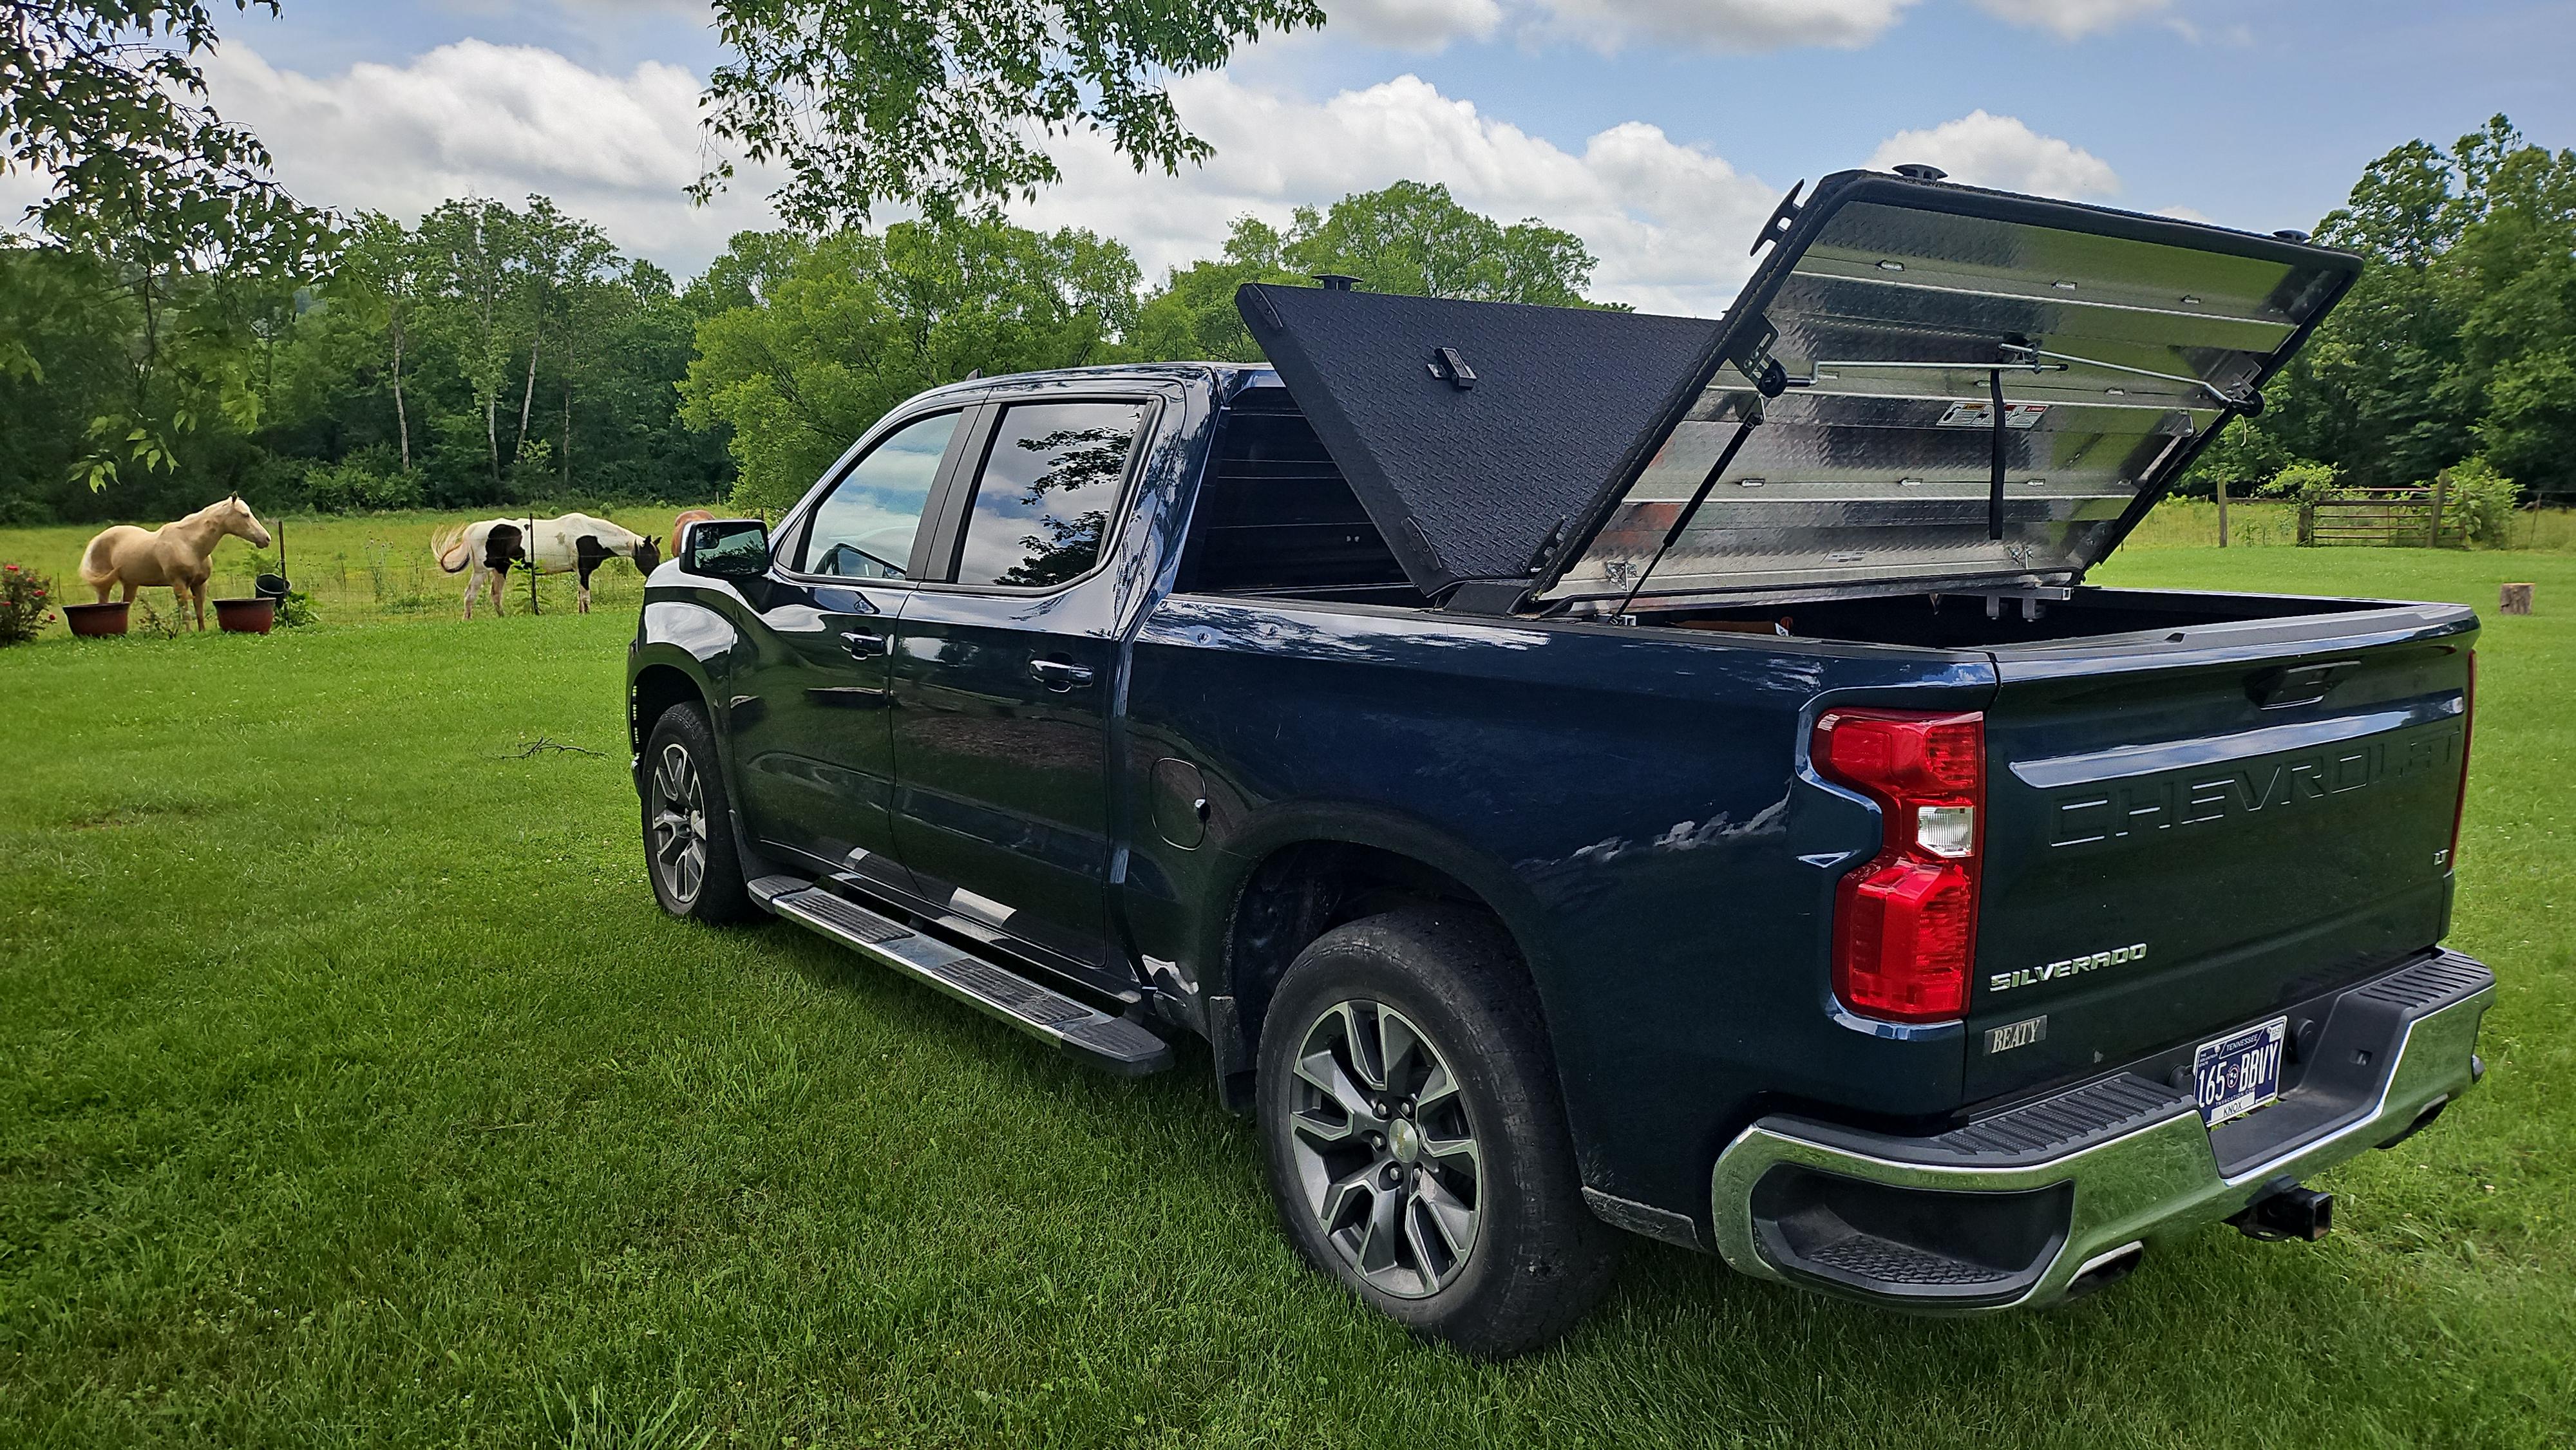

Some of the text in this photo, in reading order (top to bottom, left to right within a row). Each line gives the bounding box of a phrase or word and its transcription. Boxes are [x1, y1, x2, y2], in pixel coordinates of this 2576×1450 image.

[2050, 728, 2460, 846] CHEVROLET
[2434, 849, 2449, 865] LT
[1990, 943, 2147, 992] SILVERADO
[1991, 1019, 2040, 1053] BEATY
[2226, 1033, 2258, 1051] TENNESSEE
[2199, 1041, 2278, 1108] 165 BBVY
[2223, 1100, 2242, 1117] KNOX
